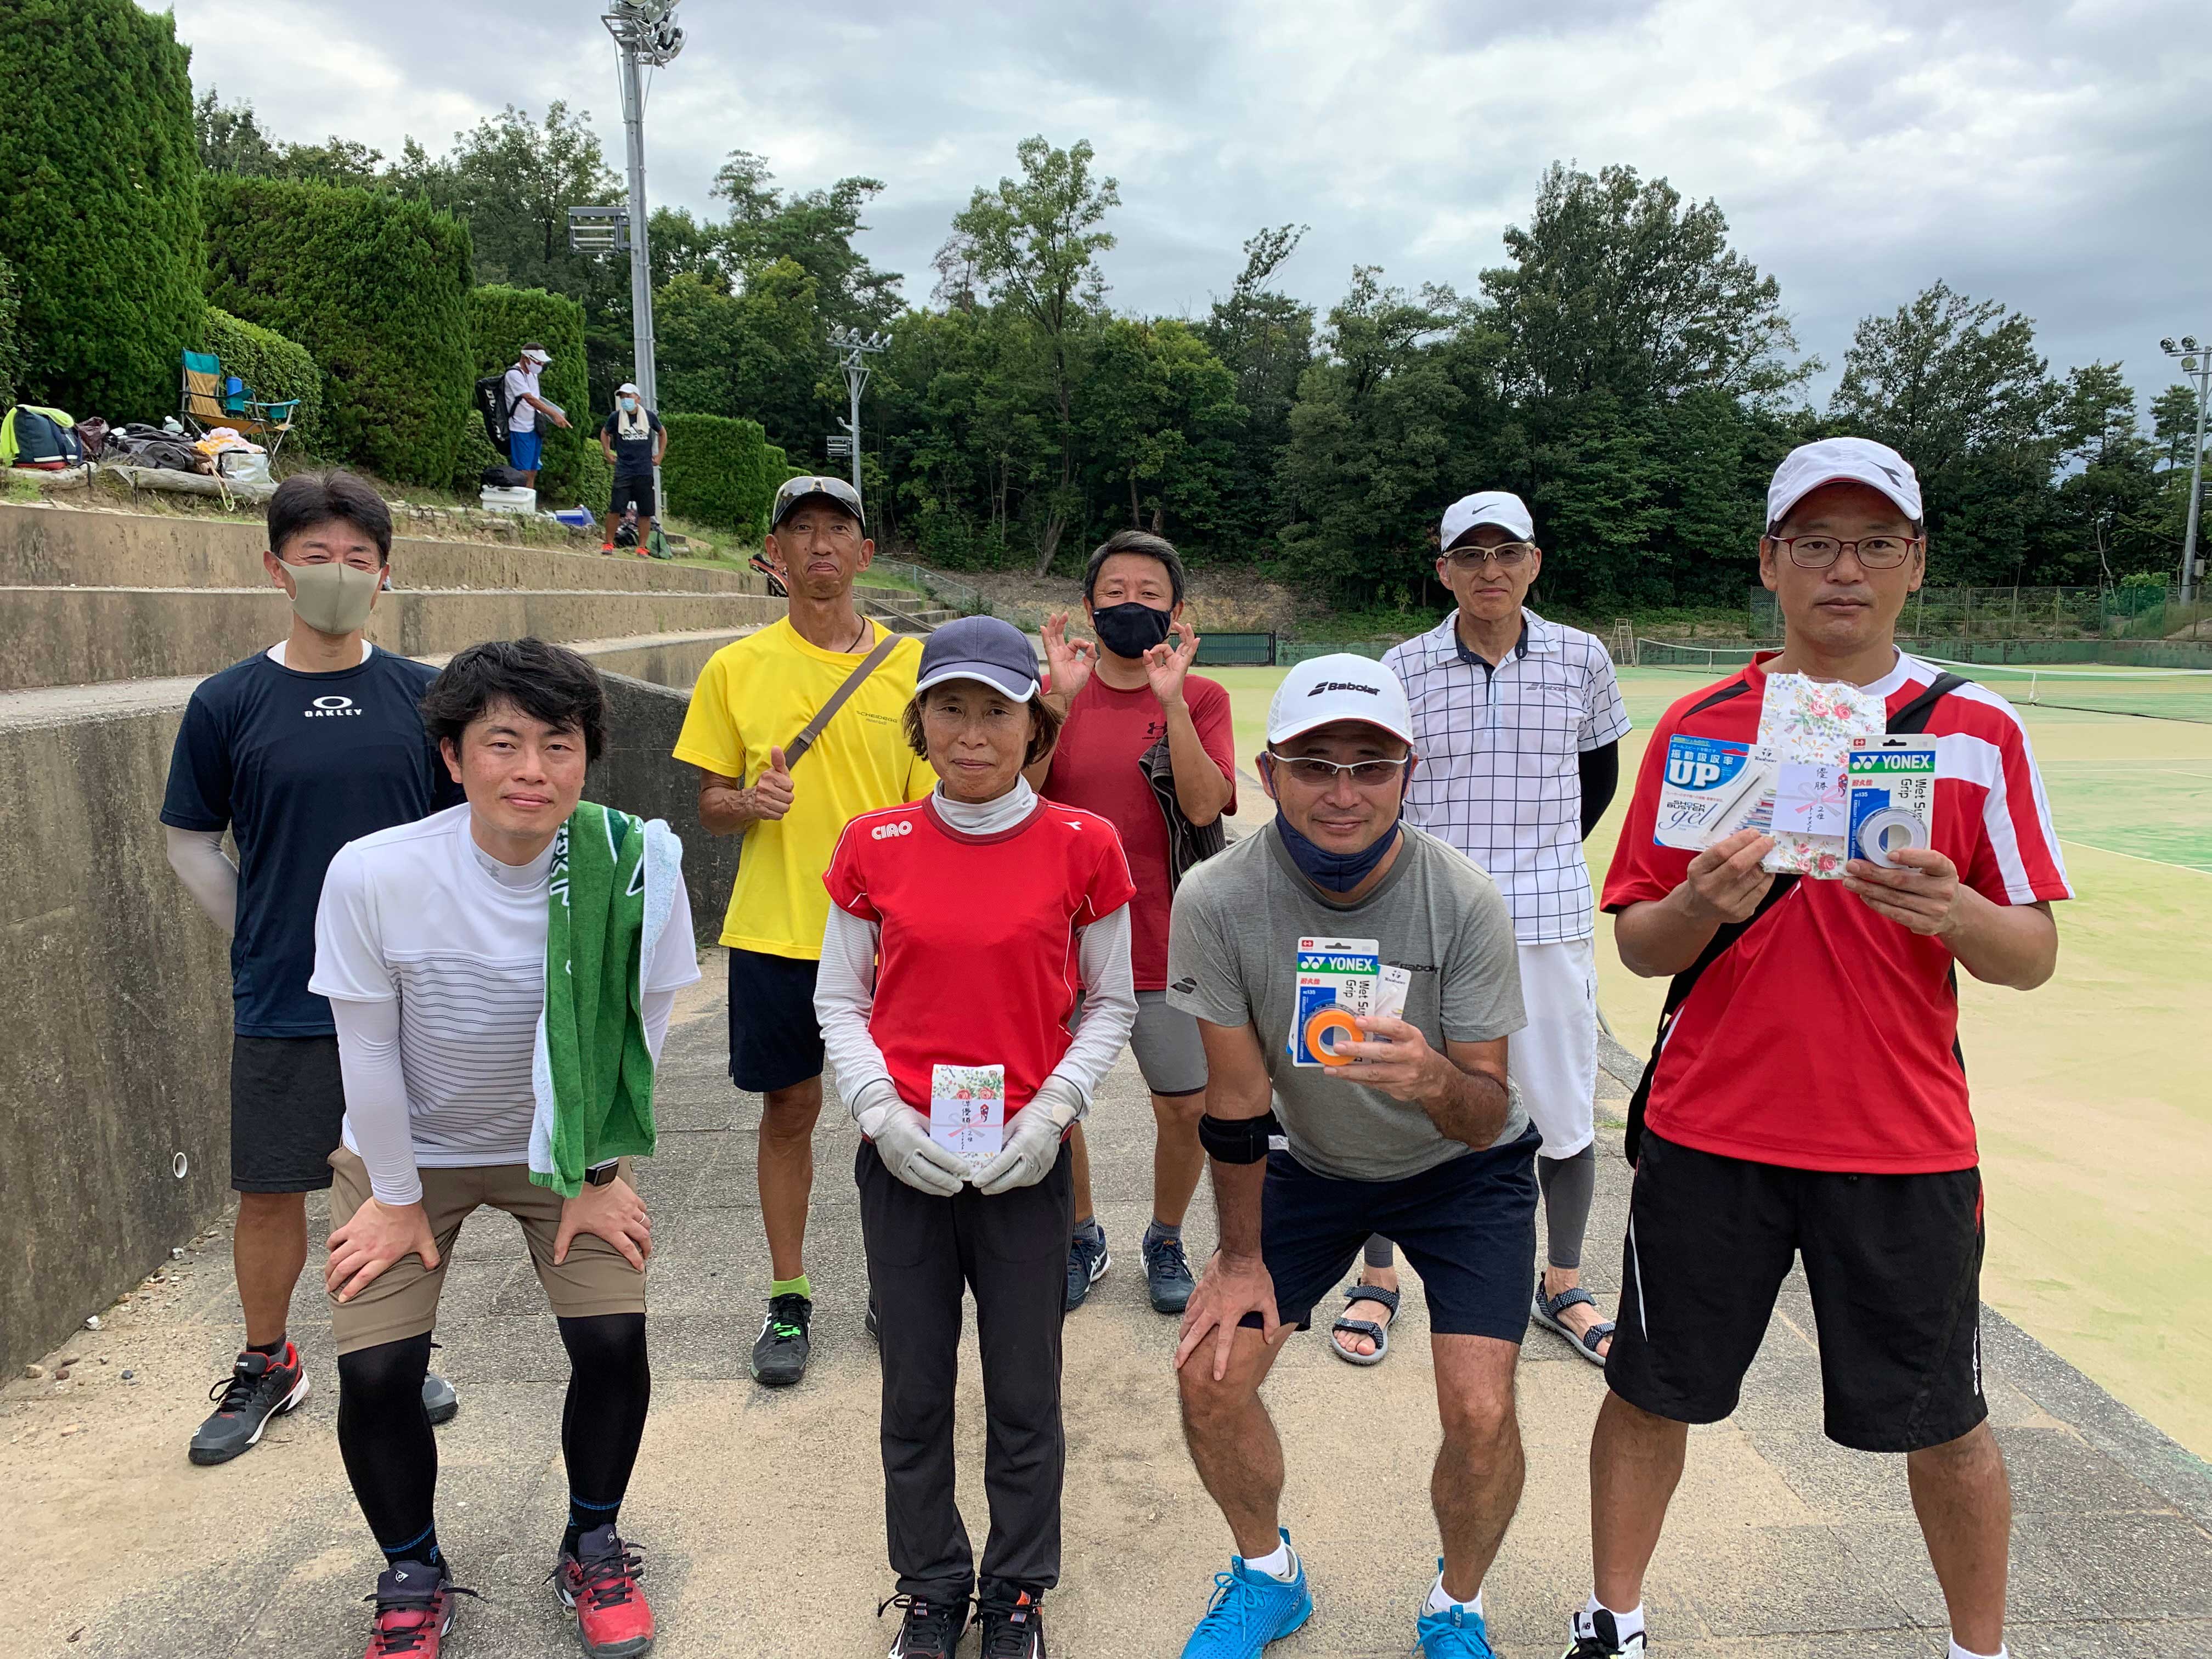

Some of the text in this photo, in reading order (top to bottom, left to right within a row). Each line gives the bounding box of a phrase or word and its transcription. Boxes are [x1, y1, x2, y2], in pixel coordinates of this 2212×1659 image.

[1328, 682, 1380, 696] Babolat
[304, 709, 362, 717] OAKLEY
[1671, 749, 1734, 765] 振動吸収率
[1882, 755, 1931, 769] YONEX
[1668, 759, 1720, 788] UP
[1814, 768, 1828, 790] 優勝
[1898, 778, 1912, 799] Grip
[1915, 778, 1927, 799] Wet
[1667, 803, 1705, 812] BUSTER
[1673, 800, 1706, 808] SHOCK
[1658, 803, 1718, 830] gel
[872, 821, 912, 840] CIAO
[1328, 957, 1373, 972] YONEX
[1343, 980, 1356, 998] Grip
[1358, 980, 1370, 998] Wet
